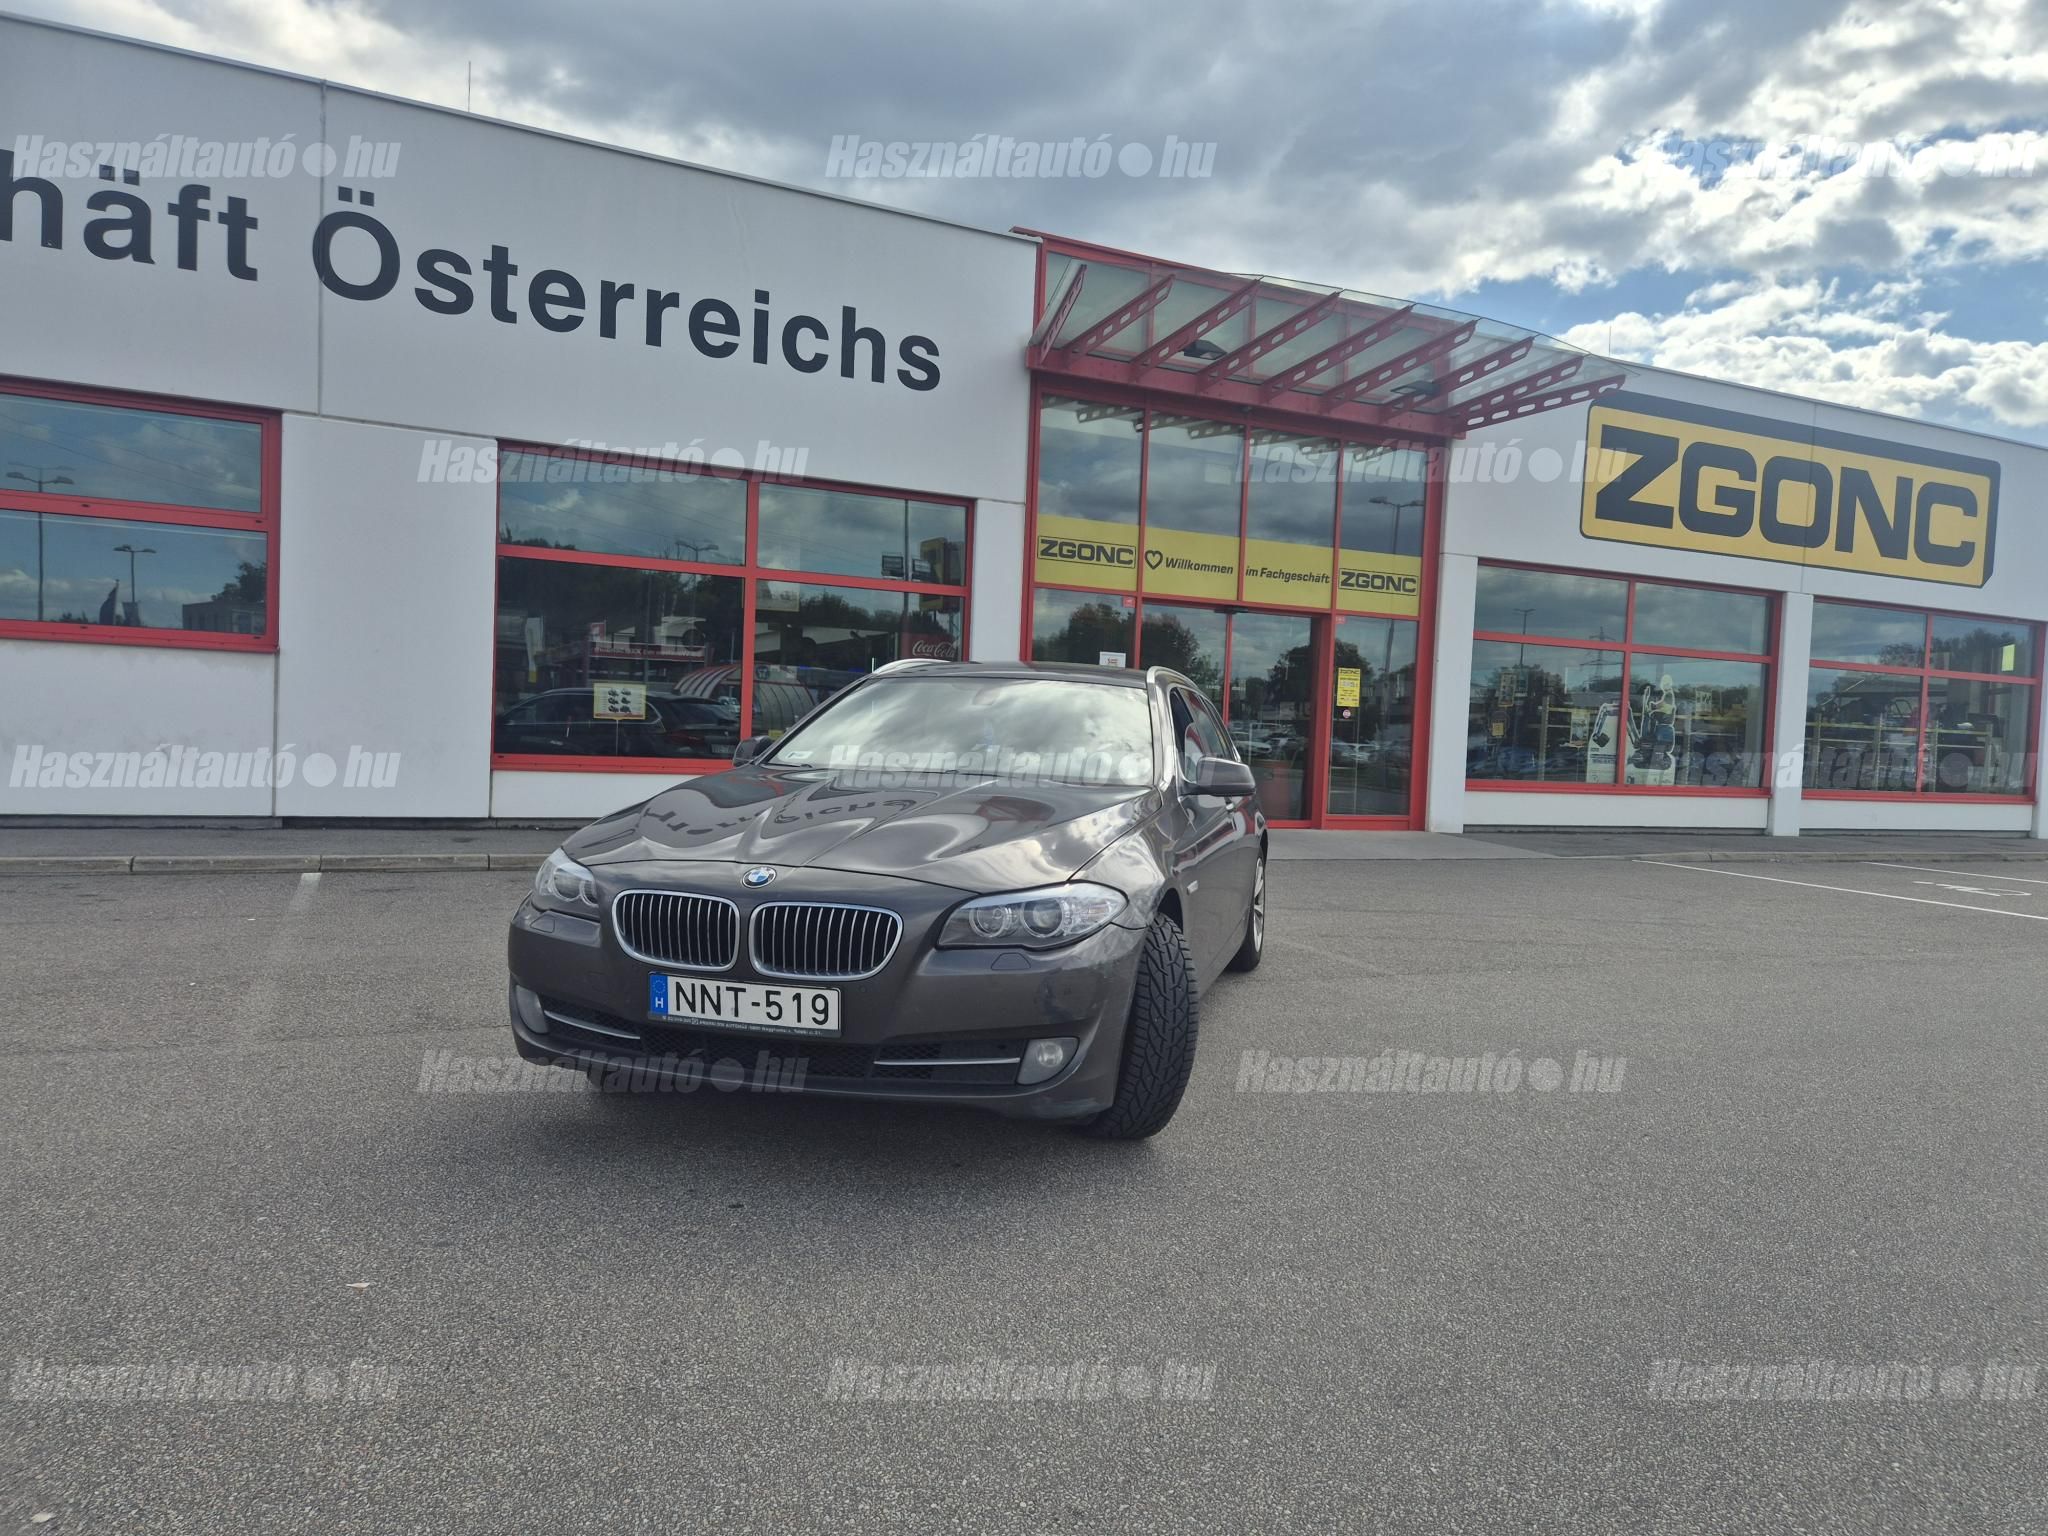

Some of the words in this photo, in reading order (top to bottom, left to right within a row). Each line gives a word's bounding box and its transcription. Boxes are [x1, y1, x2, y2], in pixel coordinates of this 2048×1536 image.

[312, 186, 940, 391] Österreichs
[1596, 424, 1978, 567] ZGONC
[1040, 539, 1134, 565] ZGONC
[1165, 556, 1234, 575] Willkommen
[1245, 567, 1258, 577] im
[1259, 567, 1331, 584] Fachgeschäft
[1341, 571, 1417, 593] ZGONC
[655, 997, 664, 1009] H
[675, 981, 829, 1026] NNT-519
